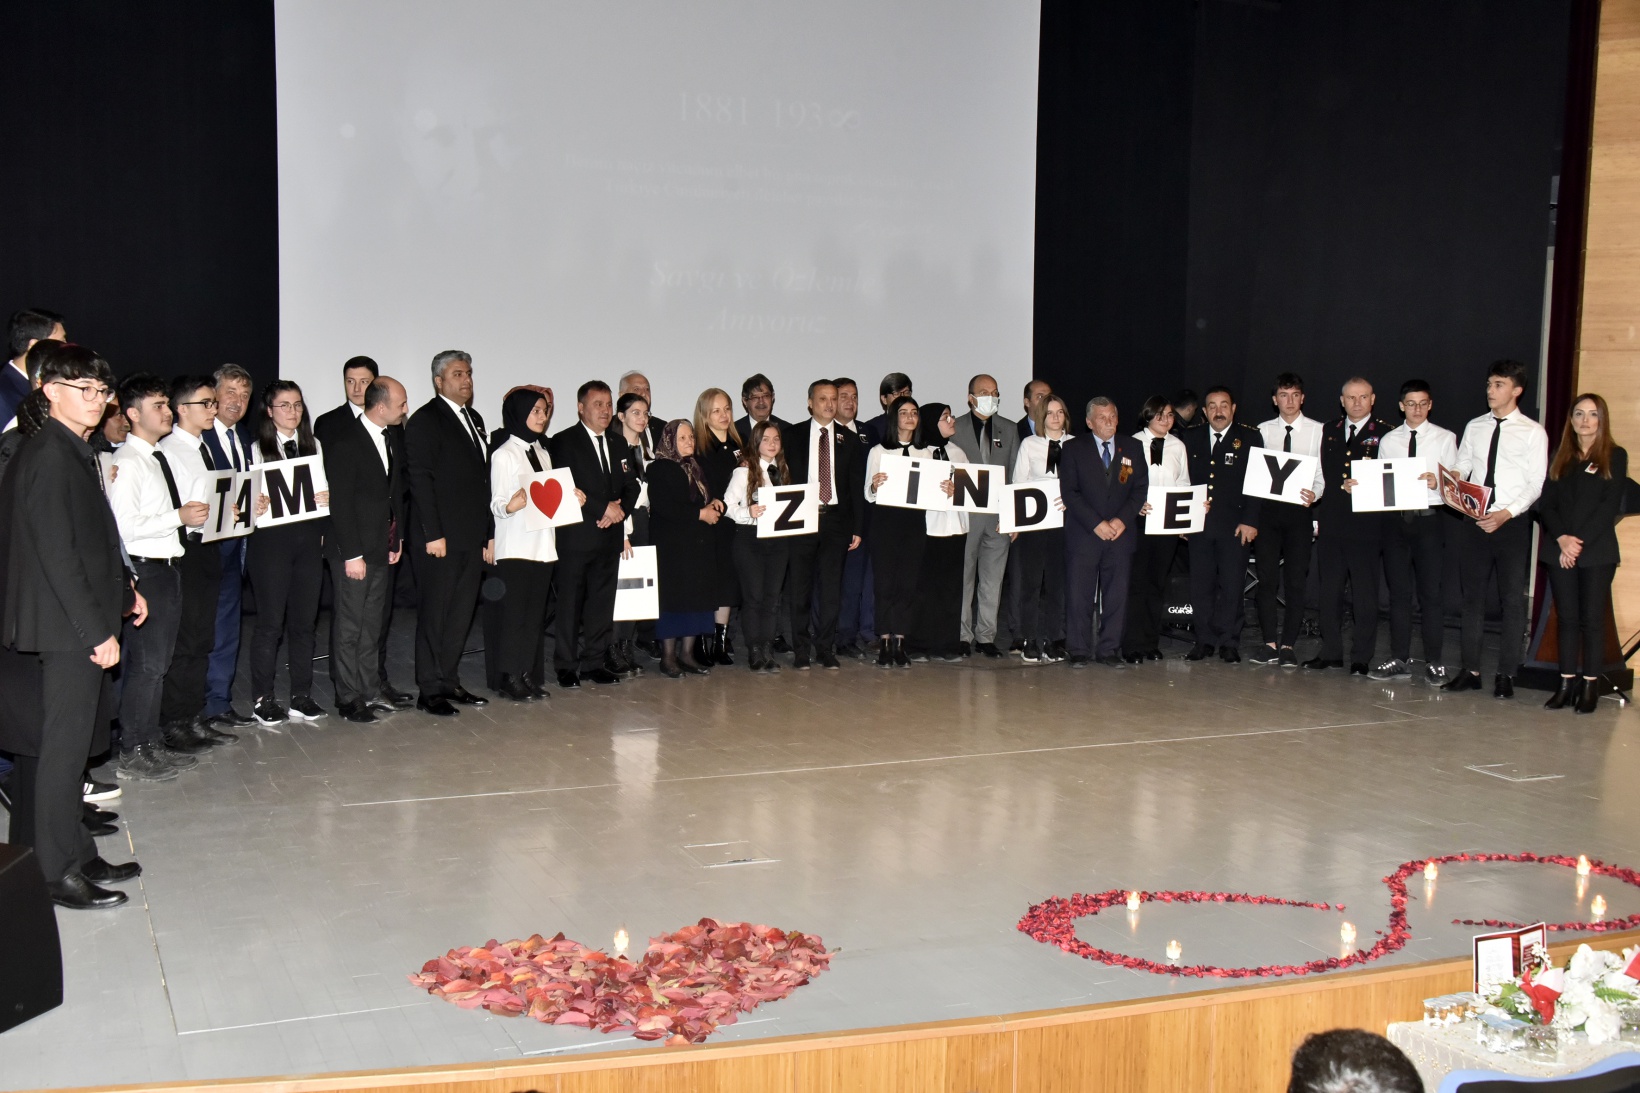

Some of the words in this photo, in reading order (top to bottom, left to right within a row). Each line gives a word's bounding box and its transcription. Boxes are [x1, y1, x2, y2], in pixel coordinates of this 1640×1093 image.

[680, 91, 747, 125] 1881
[1263, 454, 1302, 495] Y
[774, 490, 805, 531] Z
[1013, 487, 1048, 527] D
[1163, 491, 1193, 529] E
